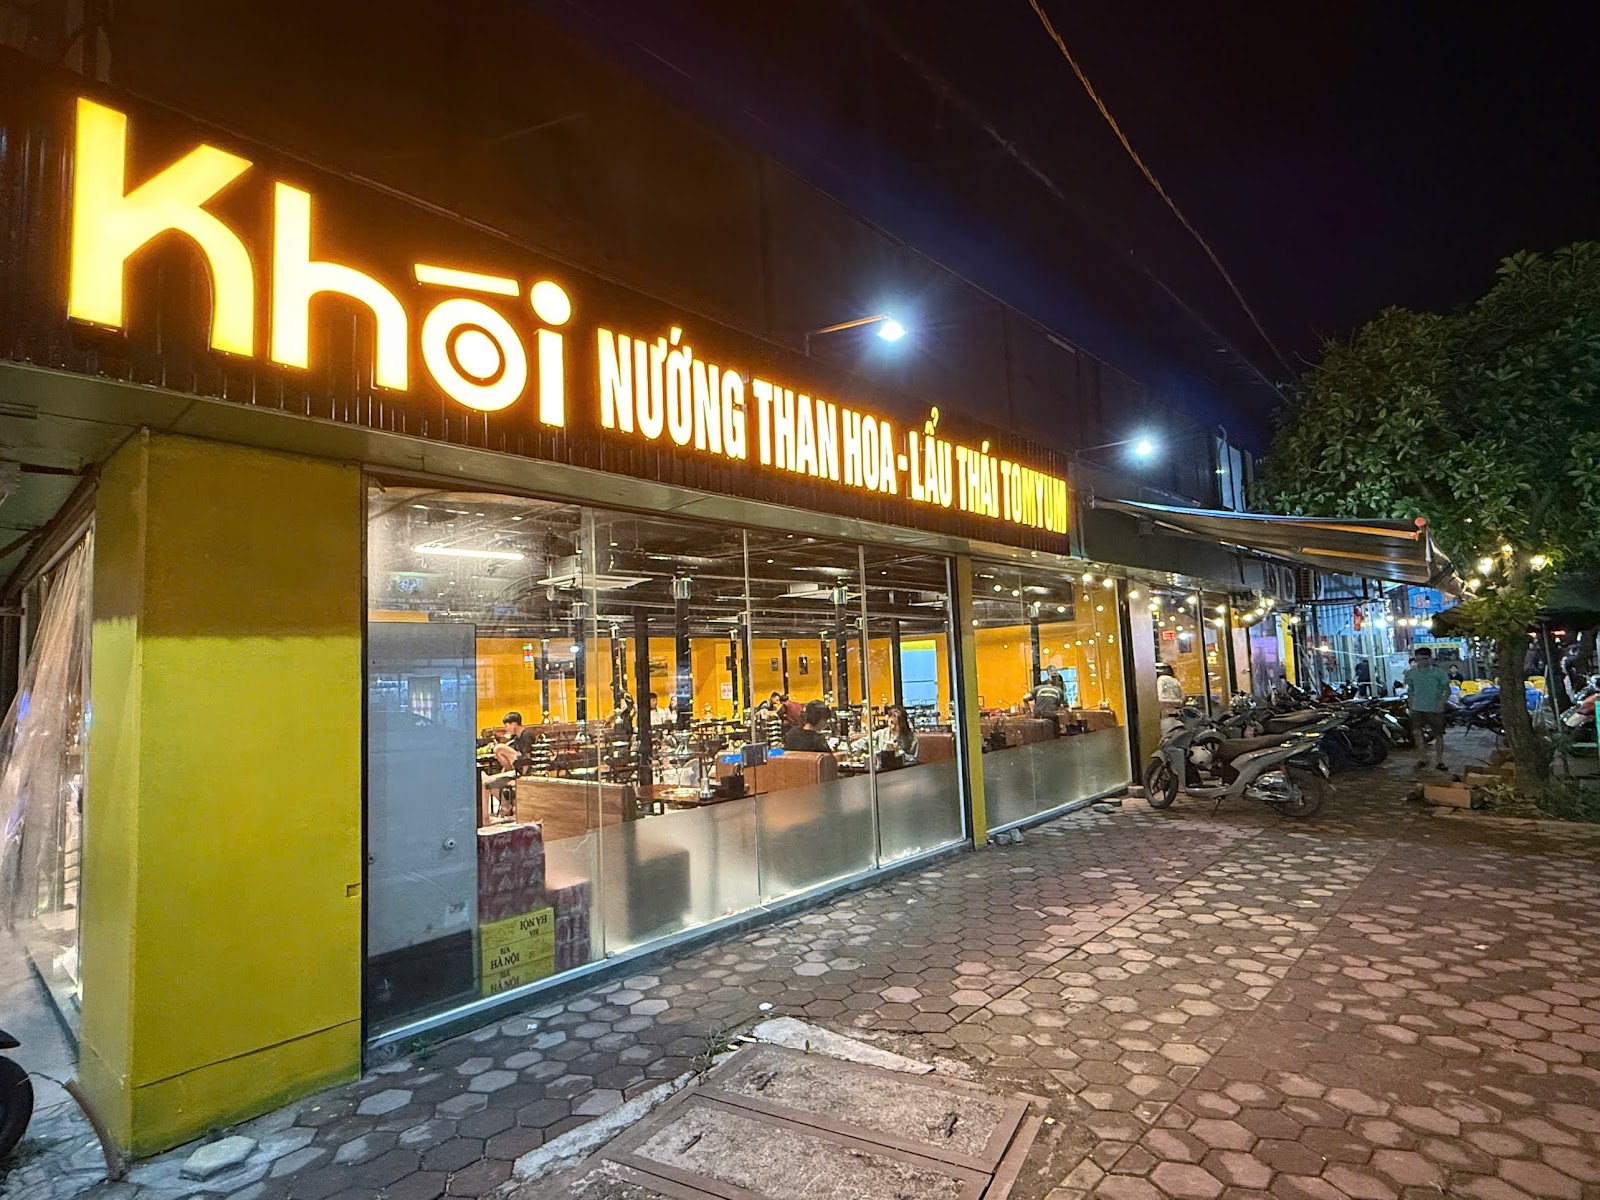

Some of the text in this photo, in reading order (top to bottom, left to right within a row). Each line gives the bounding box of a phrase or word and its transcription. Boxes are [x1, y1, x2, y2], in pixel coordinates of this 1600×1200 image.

[597, 326, 746, 460] NƯỚNG
[752, 378, 840, 482] THAN
[842, 408, 898, 495] HOA
[909, 406, 953, 508] LẨU
[956, 440, 999, 519] THÁI
[1000, 460, 1067, 534] TOMYUM
